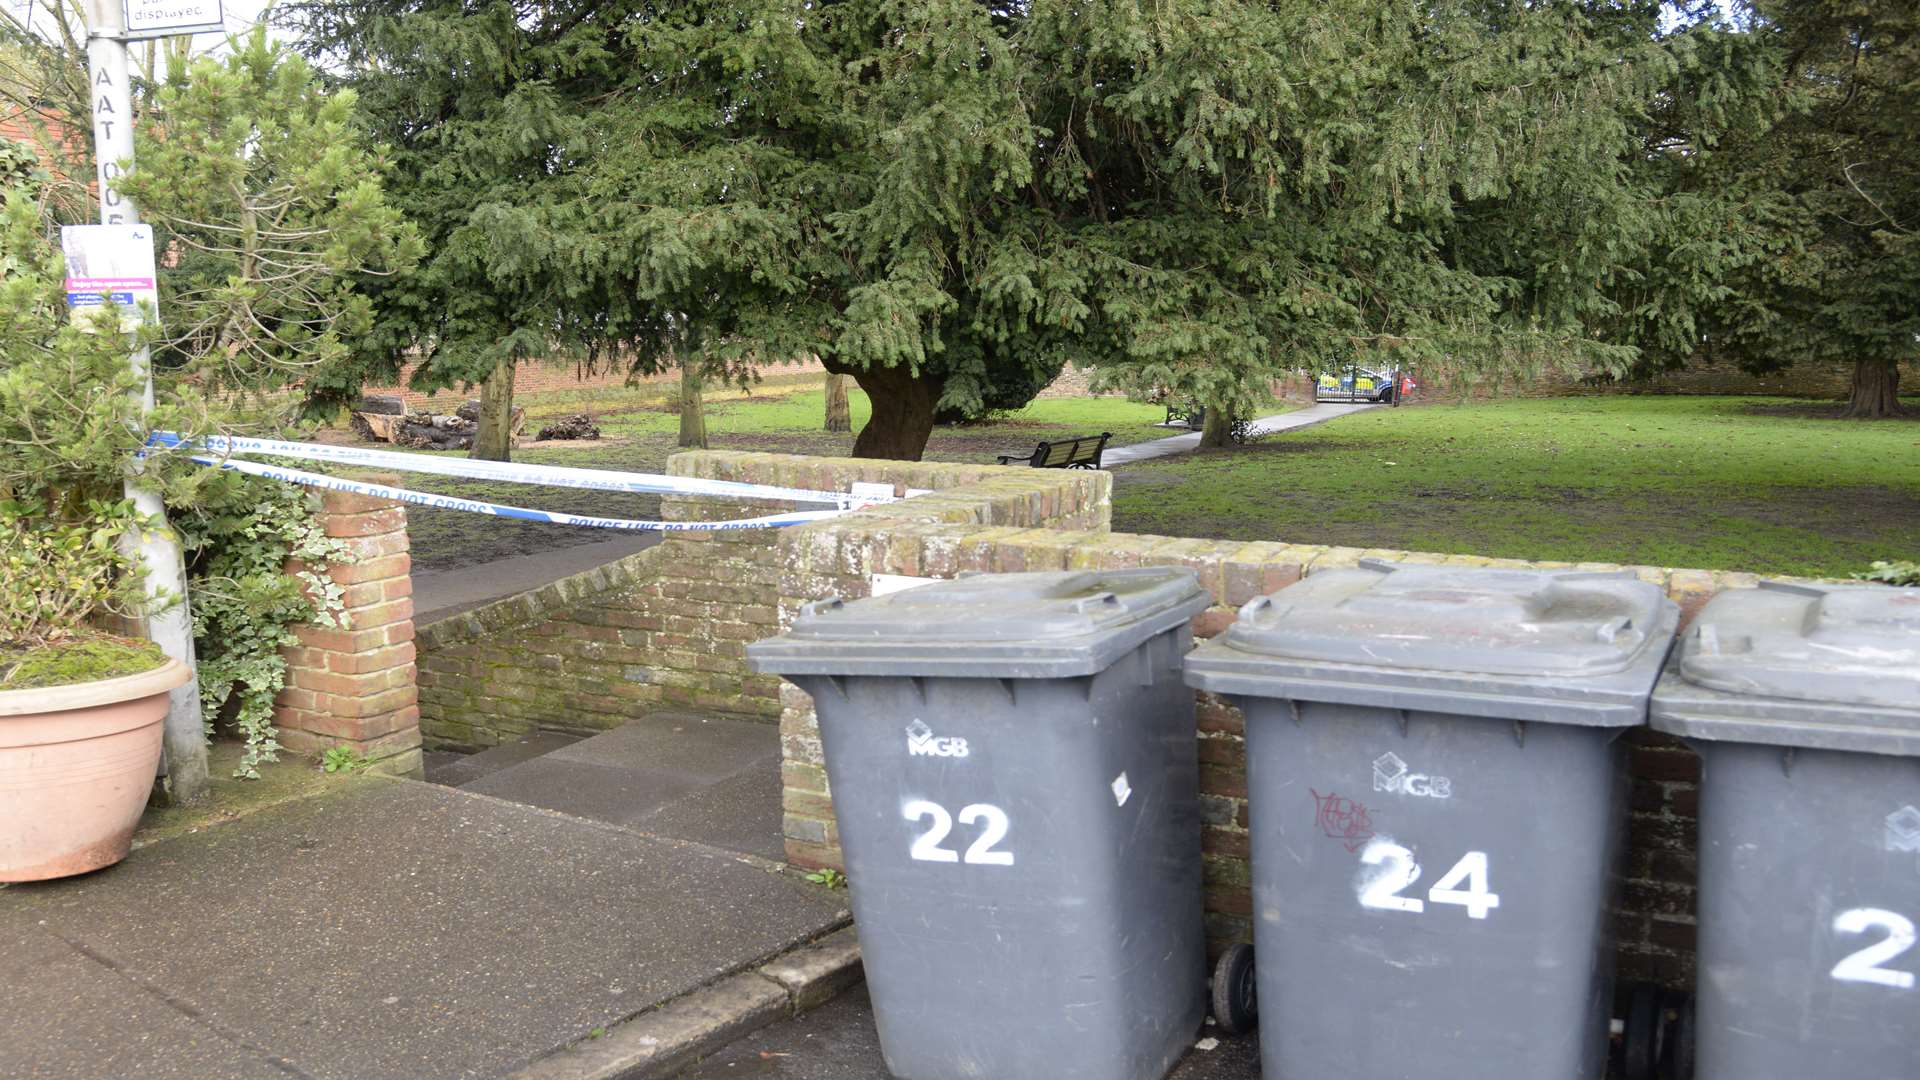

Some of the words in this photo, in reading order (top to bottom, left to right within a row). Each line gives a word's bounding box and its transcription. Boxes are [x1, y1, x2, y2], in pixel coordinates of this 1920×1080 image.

[95, 67, 116, 140] AAT
[908, 736, 969, 757] MGB
[903, 799, 1015, 866] 22
[1358, 842, 1500, 919] 24
[1830, 907, 1916, 989] 2
